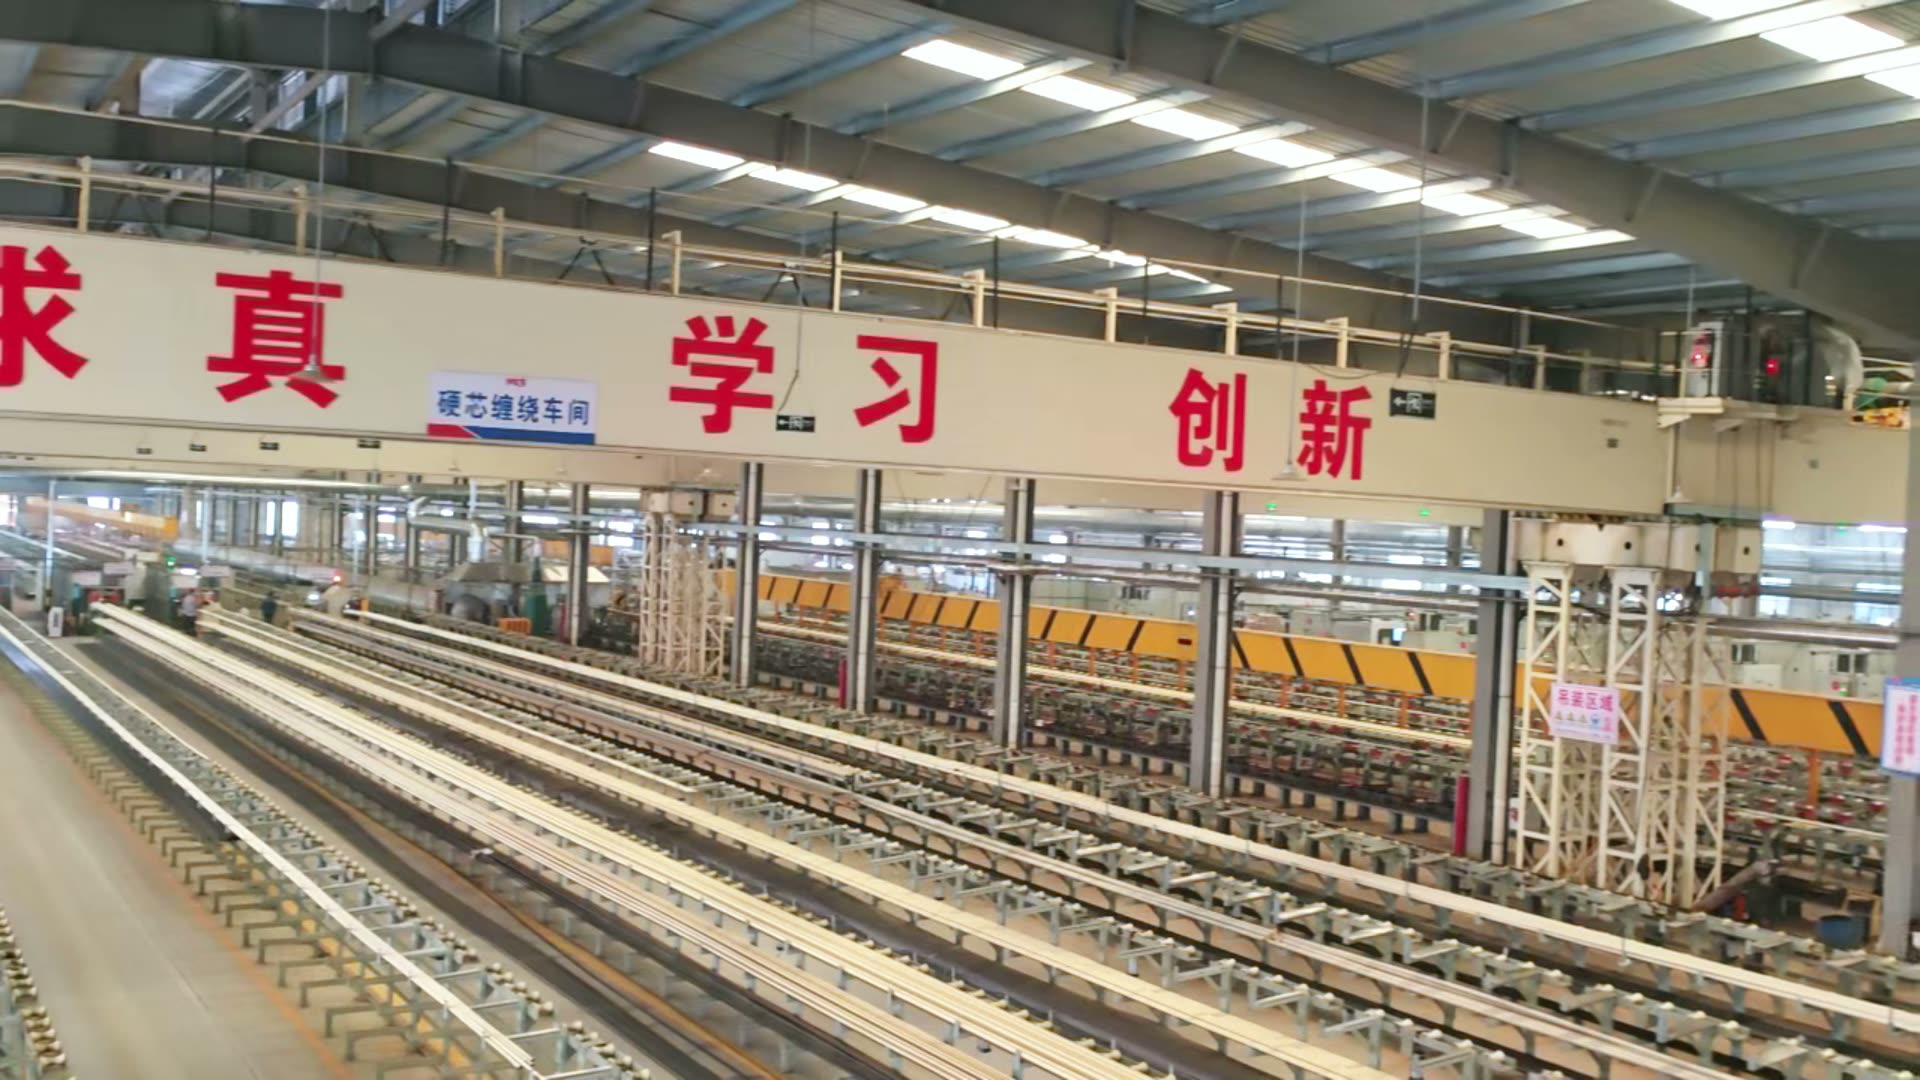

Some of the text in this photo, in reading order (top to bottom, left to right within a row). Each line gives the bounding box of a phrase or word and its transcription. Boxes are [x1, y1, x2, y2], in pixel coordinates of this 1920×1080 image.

[438, 390, 590, 426] 硬芯缠绕车间
[669, 315, 938, 443] 学习
[1170, 369, 1372, 481] 创新
